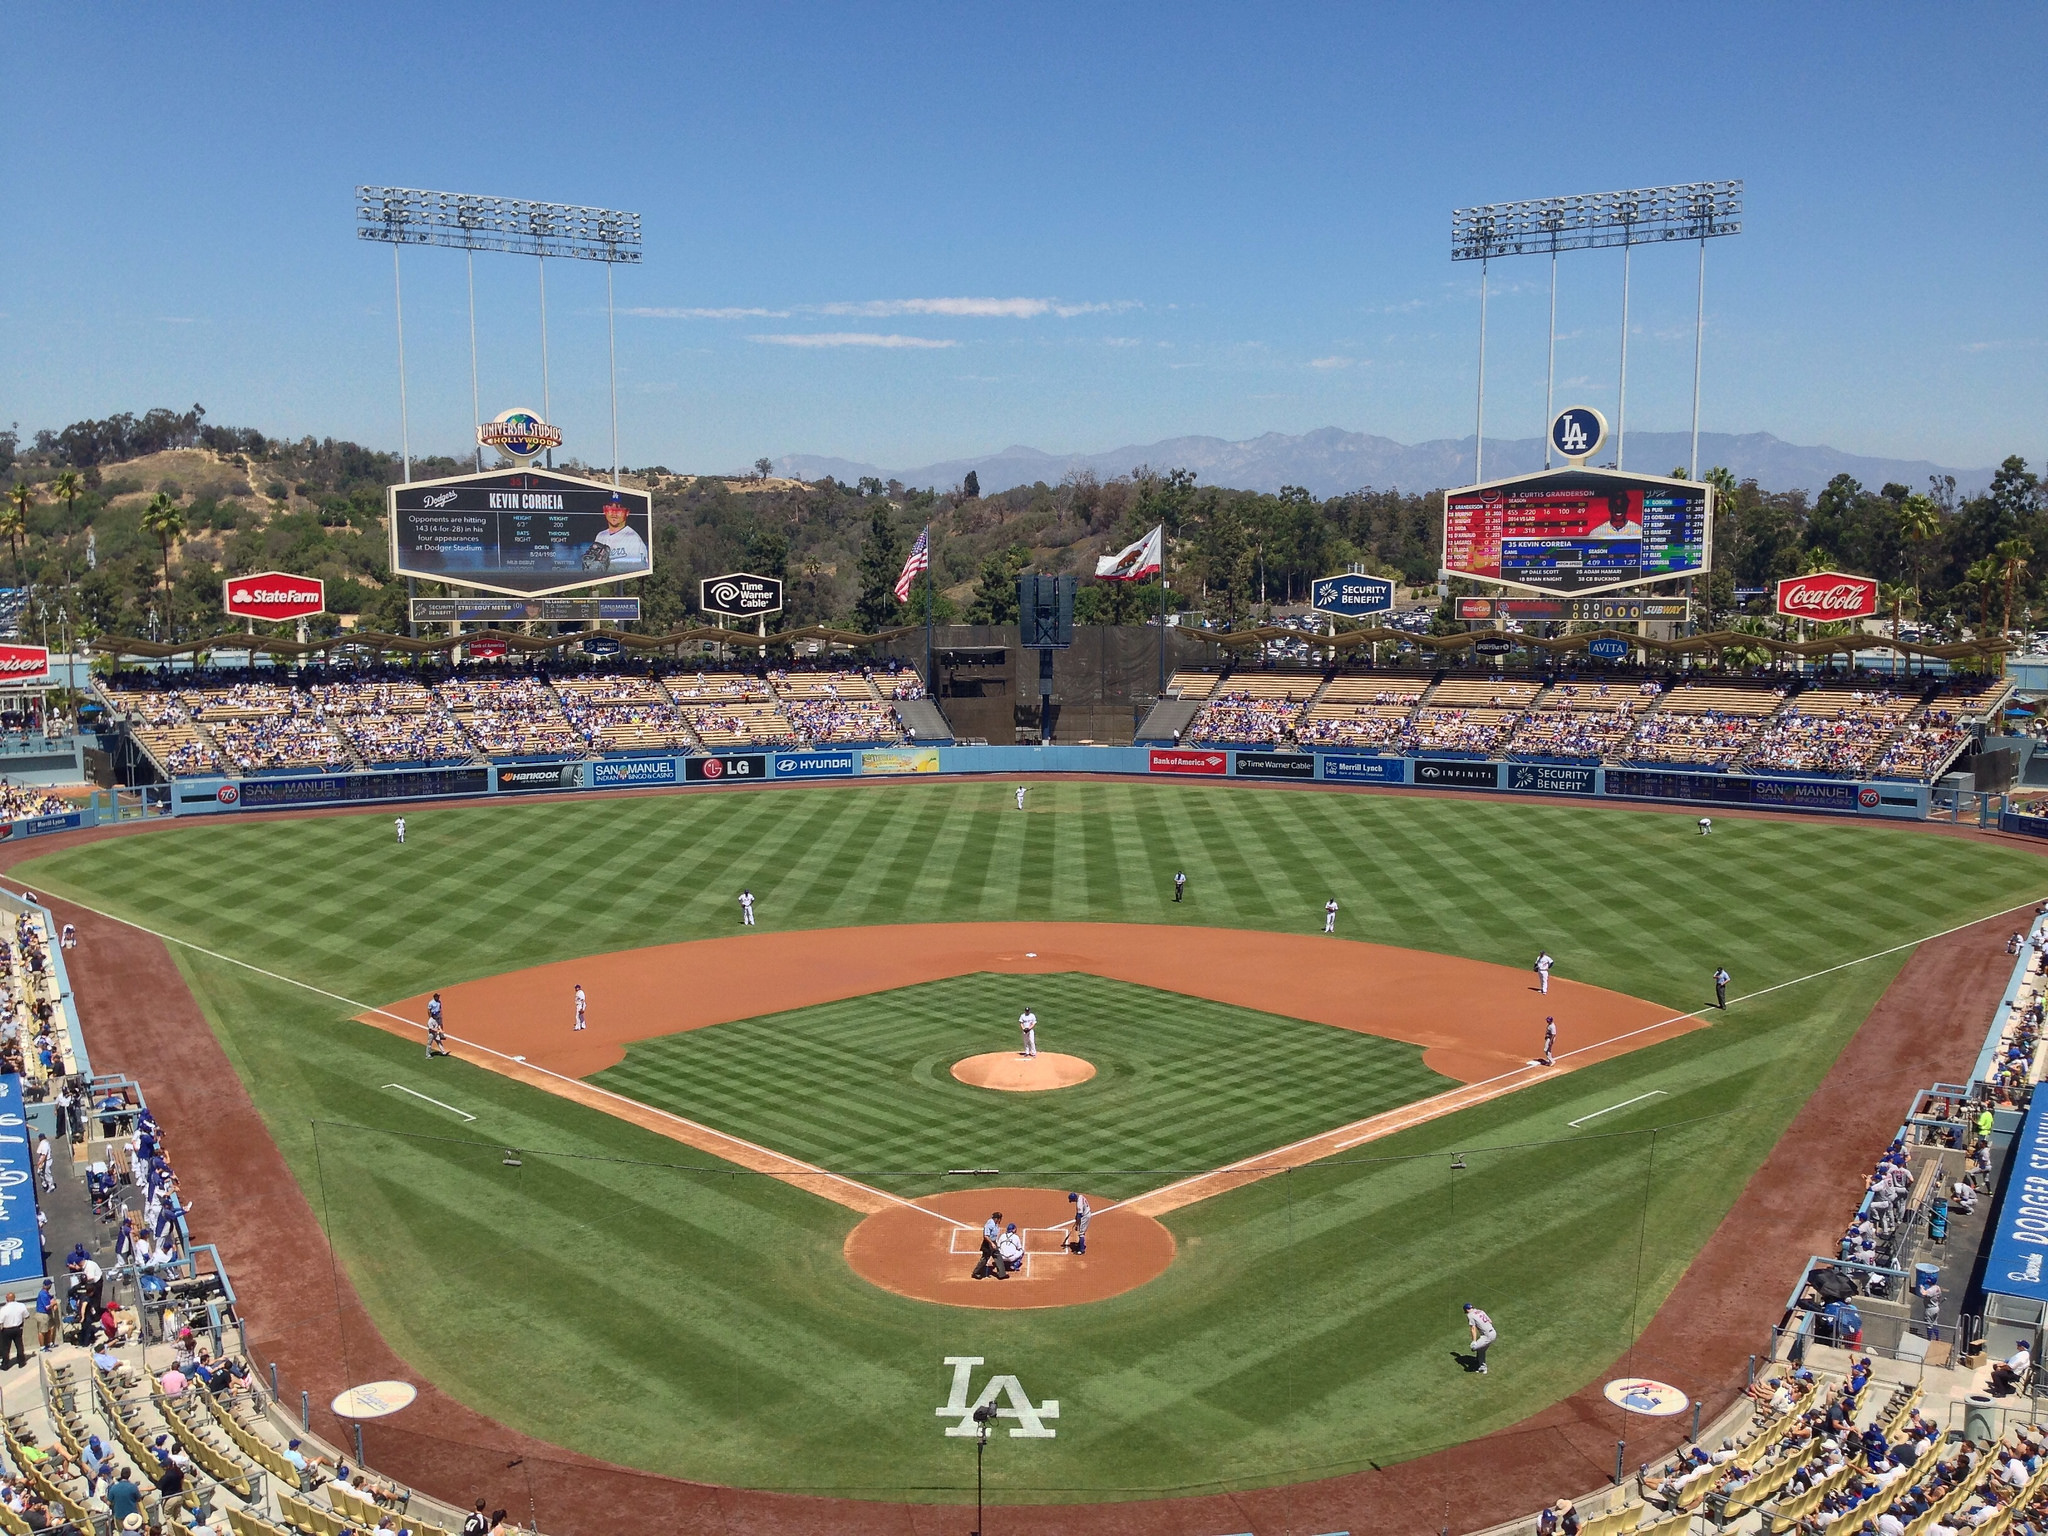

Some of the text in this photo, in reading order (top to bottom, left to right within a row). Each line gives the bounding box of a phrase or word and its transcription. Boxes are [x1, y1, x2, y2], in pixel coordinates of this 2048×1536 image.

[482, 422, 562, 440] UNIVERSAL STUDIOS
[1562, 415, 1587, 450] LA
[493, 436, 553, 446] HOLLYWOOD
[424, 490, 458, 508] Dodgers
[490, 493, 564, 510] KEVIN CORREIA
[409, 515, 449, 523] Opponents
[463, 515, 486, 525] hitting
[424, 544, 451, 552] Dodger
[740, 582, 763, 590] Time
[1342, 584, 1387, 594] SECURITY
[1342, 595, 1381, 604] BENEFIT
[1785, 584, 1869, 610] Coca-Cola
[740, 599, 767, 608] Cable
[1605, 607, 1639, 617] 0 0 0
[1644, 606, 1685, 615] SUBWAY
[1593, 644, 1624, 652] AVITA
[800, 758, 851, 770] HYUNDAI
[1153, 757, 1205, 766] Bank of America
[1247, 760, 1312, 770] Time Warner Cable
[595, 762, 673, 775] SAN MANUEL
[727, 760, 749, 775] LG
[1363, 764, 1383, 772] Lynch
[1442, 770, 1492, 779] INFINITI
[1538, 768, 1589, 780] SECURITY
[245, 784, 273, 796] SAN
[284, 780, 340, 793] MANUEL
[1538, 779, 1582, 790] BENEFIT
[1756, 782, 1784, 794] SAN
[1796, 785, 1852, 798] MANUEL
[220, 789, 236, 800] 76
[1862, 792, 1877, 804] 76
[936, 1357, 1059, 1438] LA
